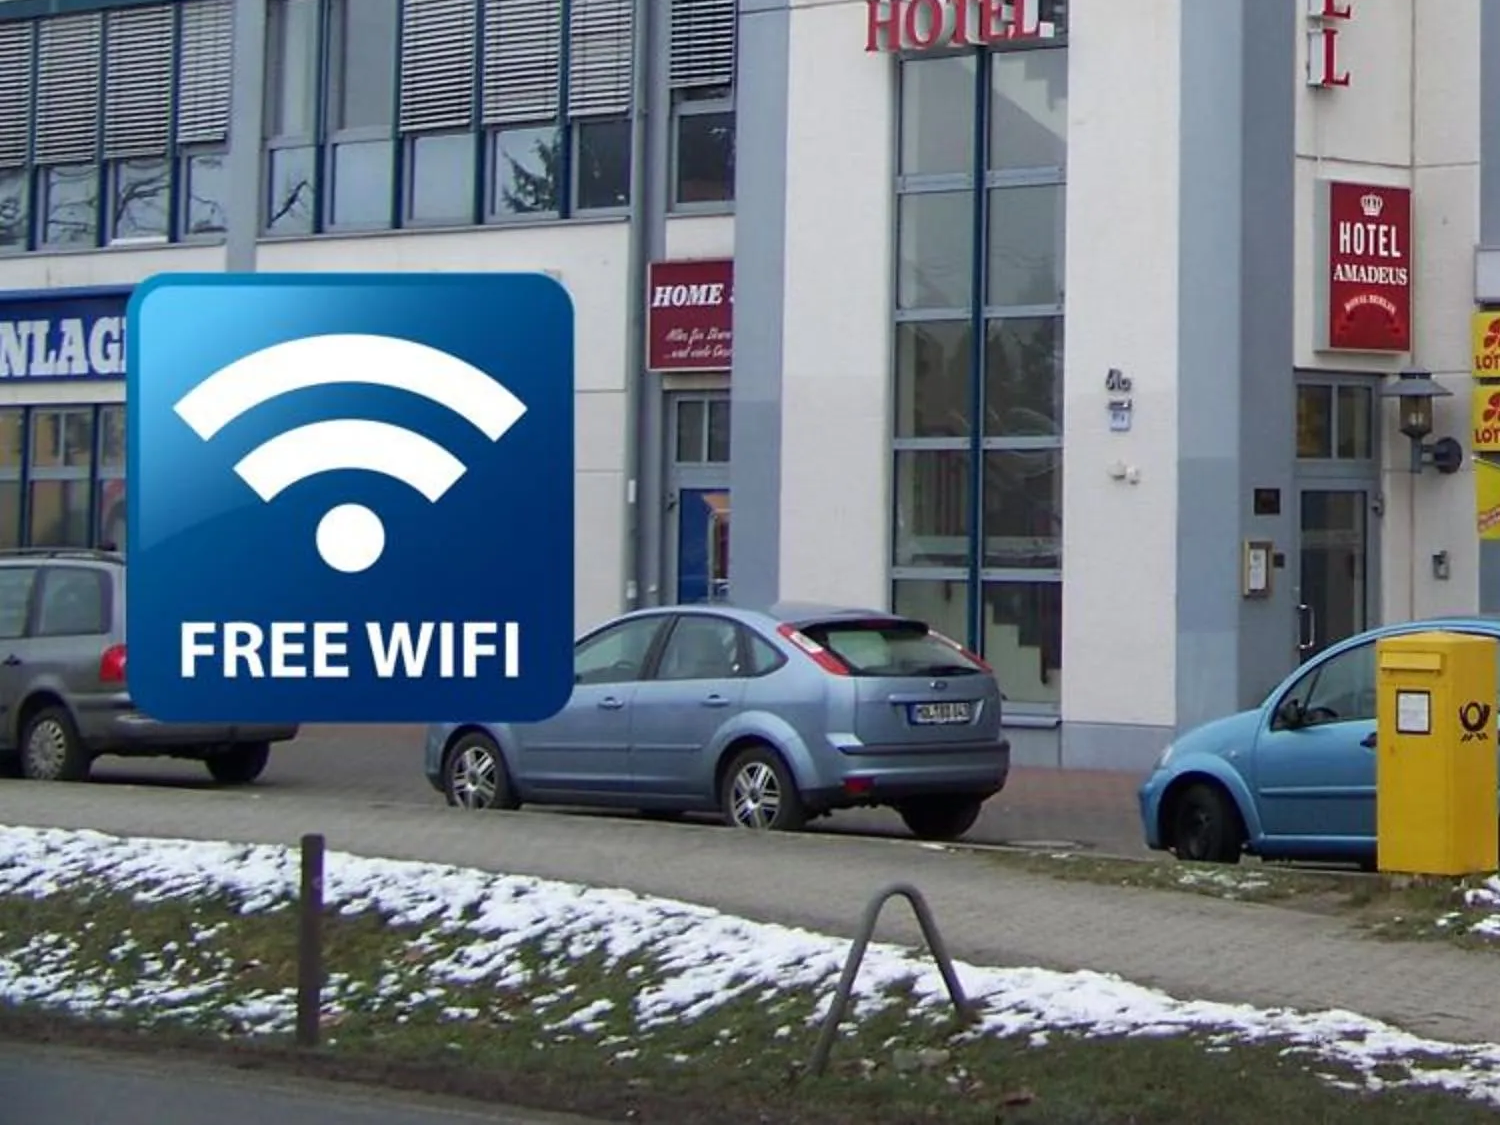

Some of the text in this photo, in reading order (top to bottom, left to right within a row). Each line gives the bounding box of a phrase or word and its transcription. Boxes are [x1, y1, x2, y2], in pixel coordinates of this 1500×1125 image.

[1339, 221, 1402, 258] HOTEL
[1333, 263, 1408, 286] AMADEUS
[652, 282, 725, 308] HOME
[0, 316, 126, 377] NLAG
